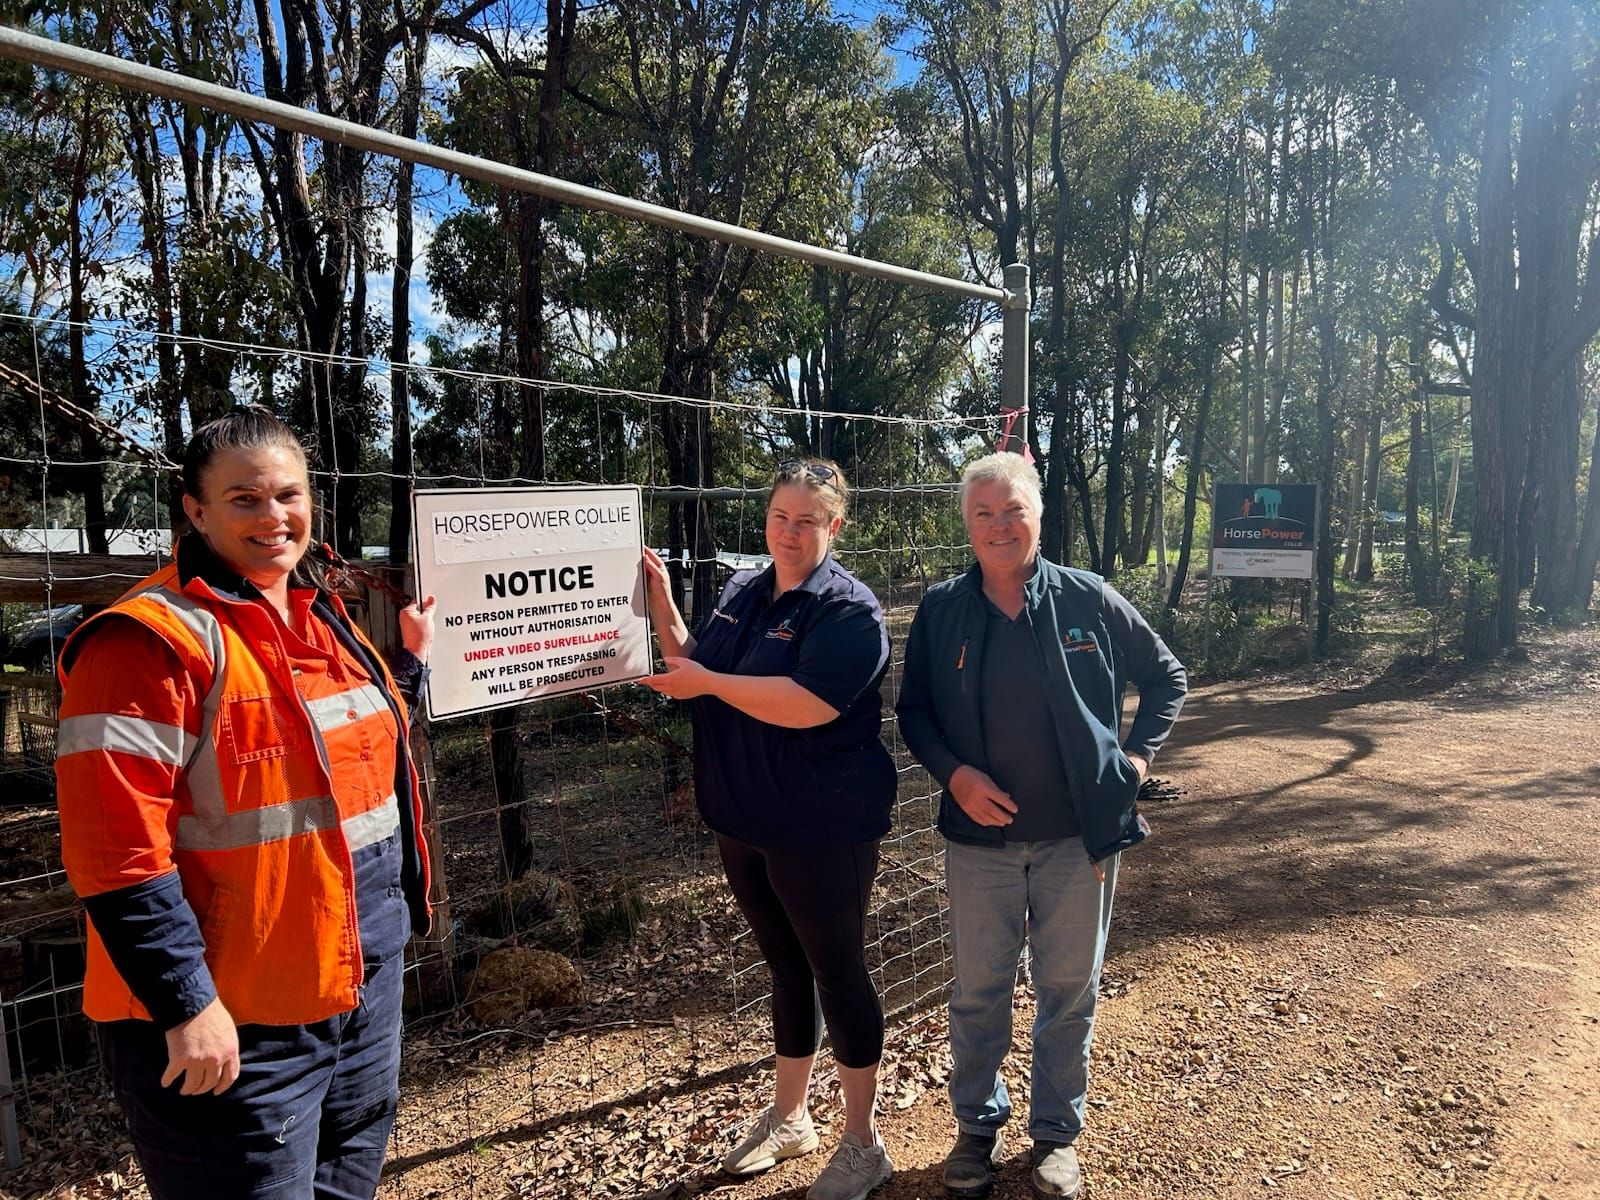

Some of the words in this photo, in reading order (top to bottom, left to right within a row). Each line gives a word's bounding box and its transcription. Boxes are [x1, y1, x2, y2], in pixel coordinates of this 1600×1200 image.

[434, 510, 570, 534] HORSEPOWER
[575, 506, 631, 525] COLLIE
[1223, 527, 1304, 539] HorsePower
[484, 565, 595, 599] NOTICE
[445, 615, 463, 627] NO
[467, 609, 514, 625] PERSON
[517, 602, 578, 618] PERMITTED
[580, 600, 595, 610] TO
[597, 596, 629, 608] ENTER
[470, 625, 524, 642] WITHOUT
[527, 613, 612, 634] AUTHORISATION
[464, 646, 504, 662] UNDER
[507, 641, 541, 656] VIDEO
[544, 629, 620, 650] SURVEILLANCE
[471, 667, 496, 681] ANY
[499, 661, 544, 677] PERSON
[546, 648, 617, 669] TRESPASSING
[488, 682, 516, 695] WILL
[519, 678, 534, 689] BE
[536, 665, 605, 687] PROSECUTED
